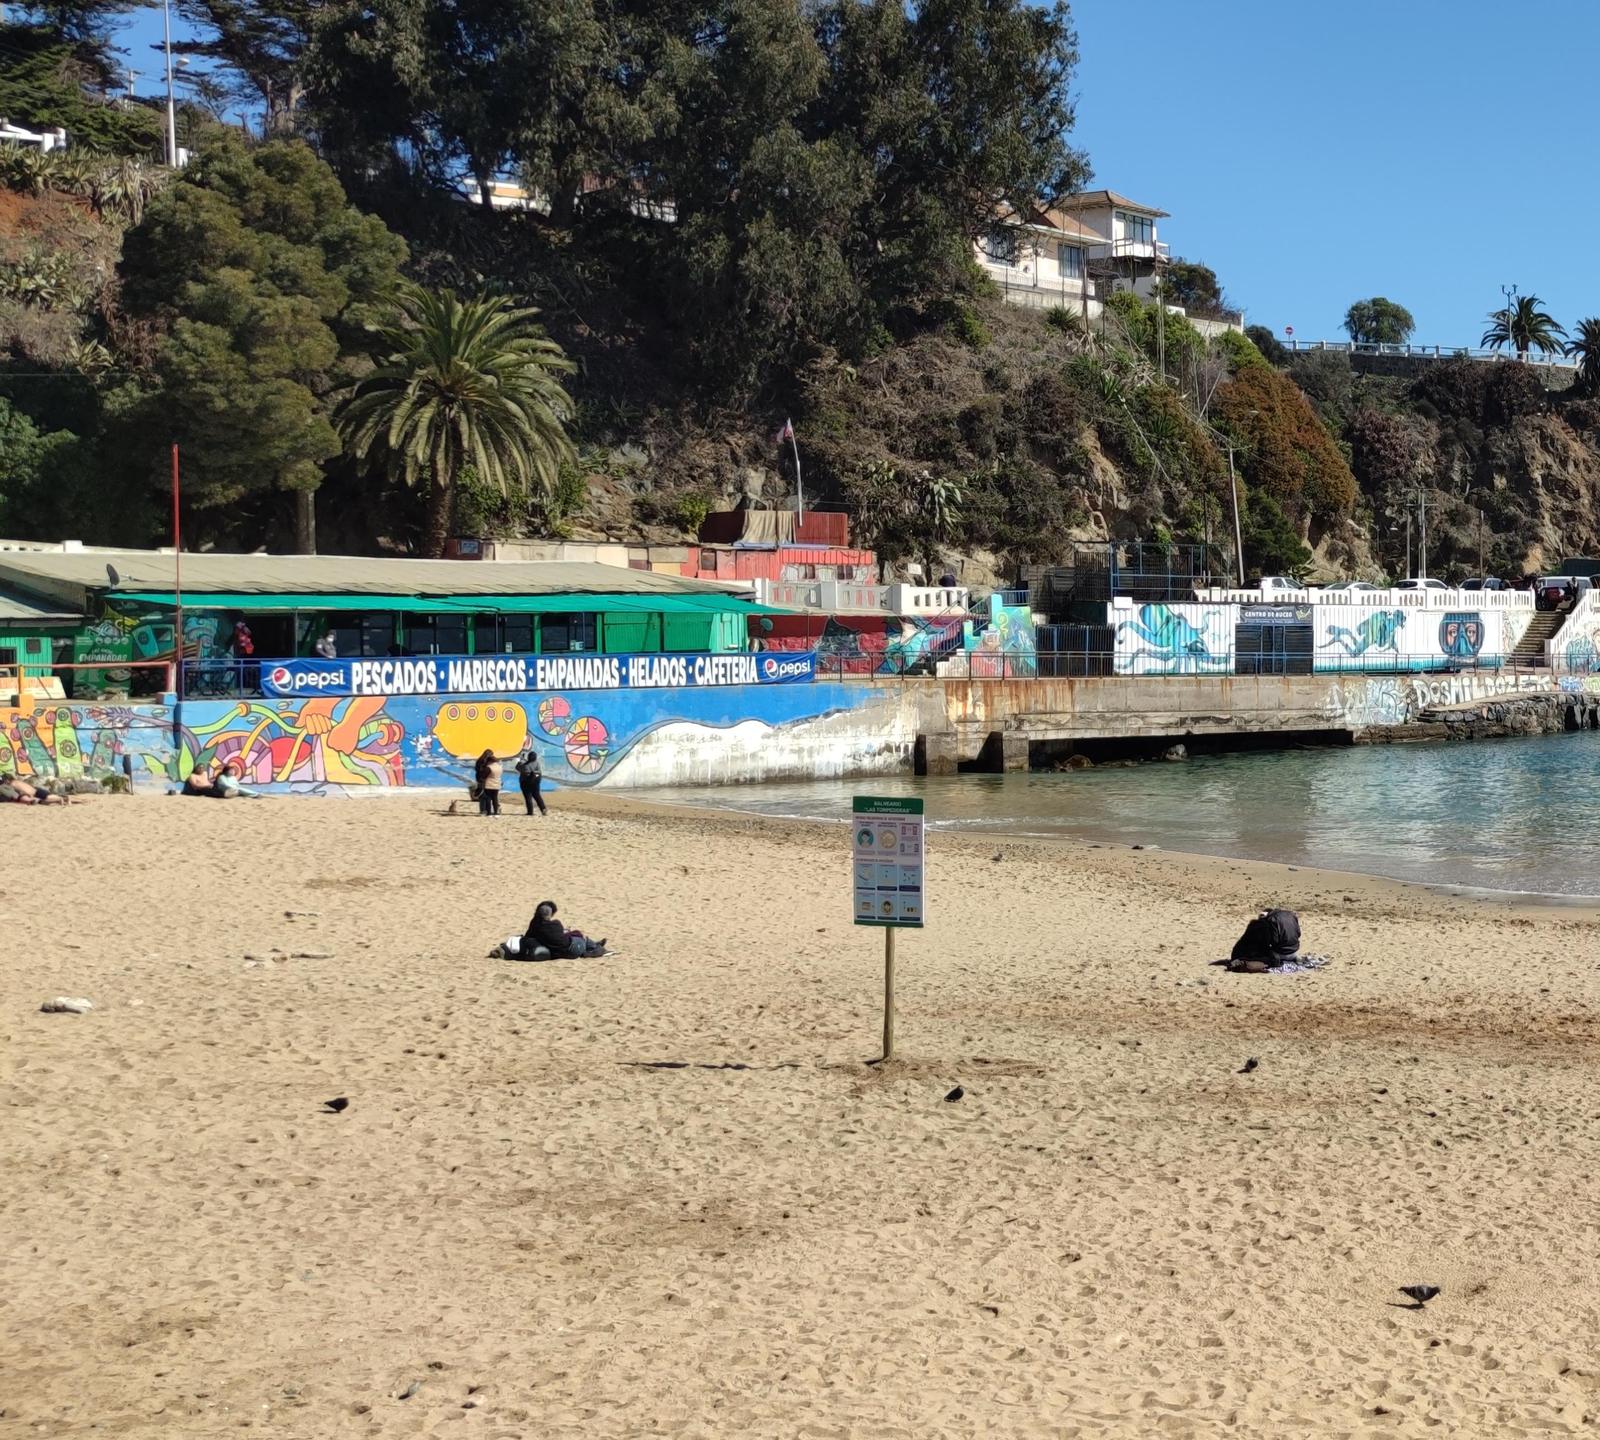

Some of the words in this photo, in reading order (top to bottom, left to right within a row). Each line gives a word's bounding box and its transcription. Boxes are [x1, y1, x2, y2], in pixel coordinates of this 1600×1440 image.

[79, 653, 128, 662] EMPANADAS
[352, 661, 437, 695] PESCADOS
[448, 659, 527, 692] MARISCOS
[536, 656, 619, 690] EMPANADAS
[628, 656, 687, 687] HELADOS
[694, 655, 759, 684] CAFETERIA
[779, 661, 811, 678] pepsi
[295, 669, 344, 689] pepsi
